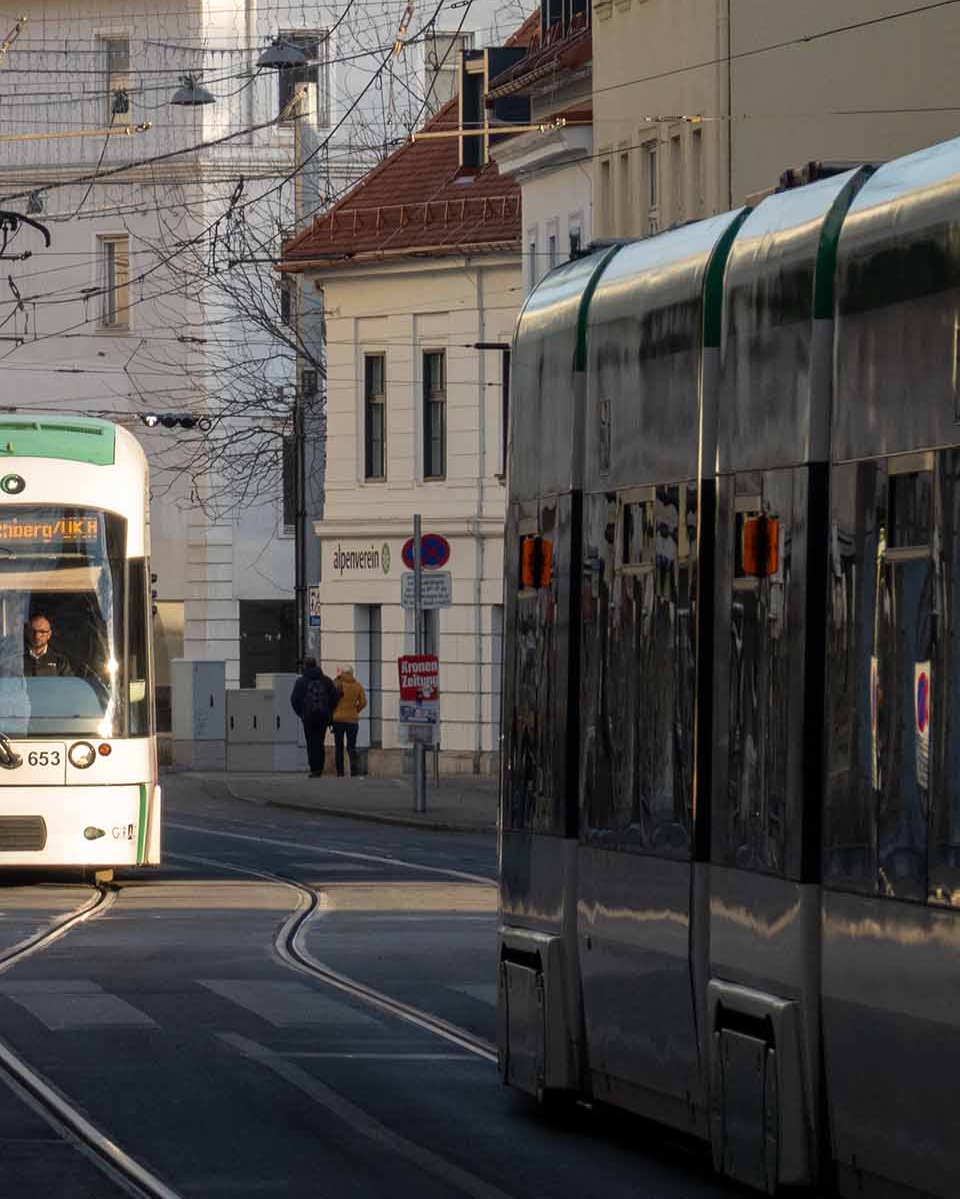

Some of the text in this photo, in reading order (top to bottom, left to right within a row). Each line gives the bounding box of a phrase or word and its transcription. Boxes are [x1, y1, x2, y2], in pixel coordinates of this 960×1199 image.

[333, 543, 380, 575] alpenverein
[401, 661, 438, 674] Kronen
[401, 675, 440, 688] Zeitung
[28, 752, 61, 766] 653
